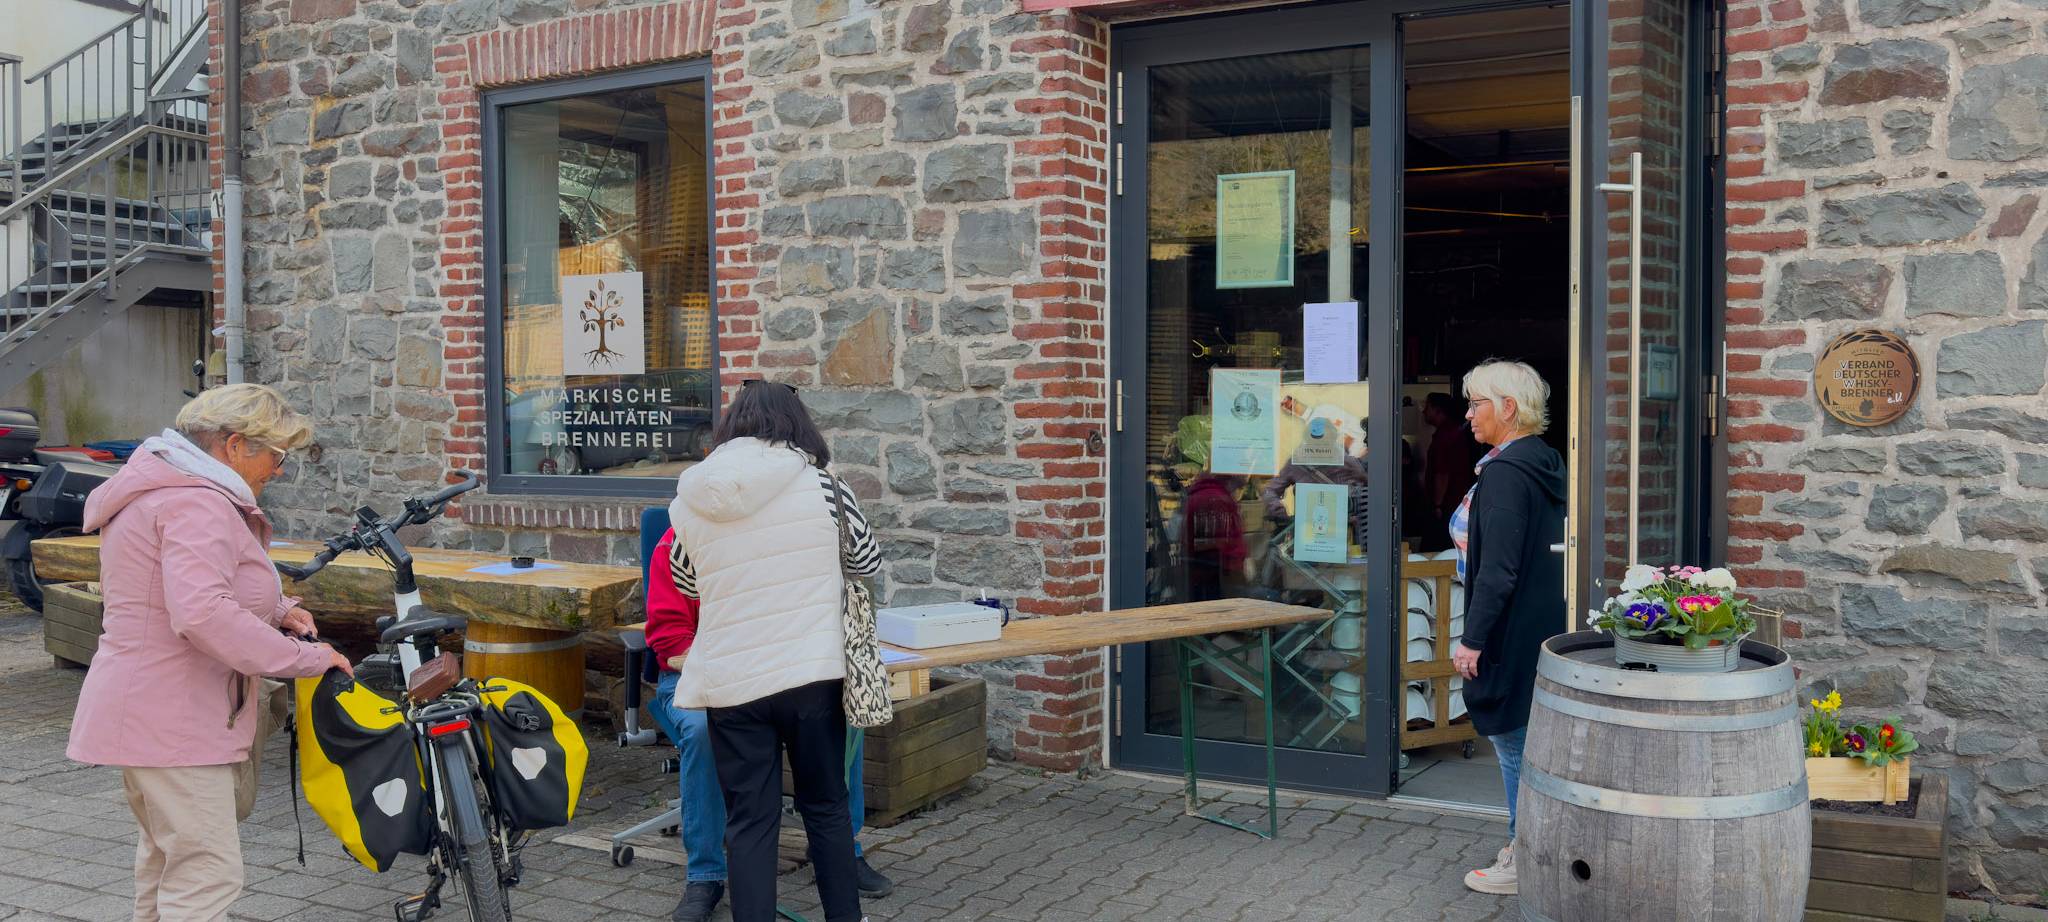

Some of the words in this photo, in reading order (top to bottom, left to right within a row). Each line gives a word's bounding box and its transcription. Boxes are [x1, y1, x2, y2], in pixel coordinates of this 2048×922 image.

[1840, 360, 1895, 369] VERBAND
[1834, 370, 1901, 379] DEUTSCHER
[1844, 379, 1892, 388] WHISKY-
[541, 387, 672, 403] MÄRKISCHE
[1840, 388, 1894, 398] BRENNER
[541, 408, 672, 426] SPEZIALITÄTEN
[542, 432, 672, 447] BRENNEREI
